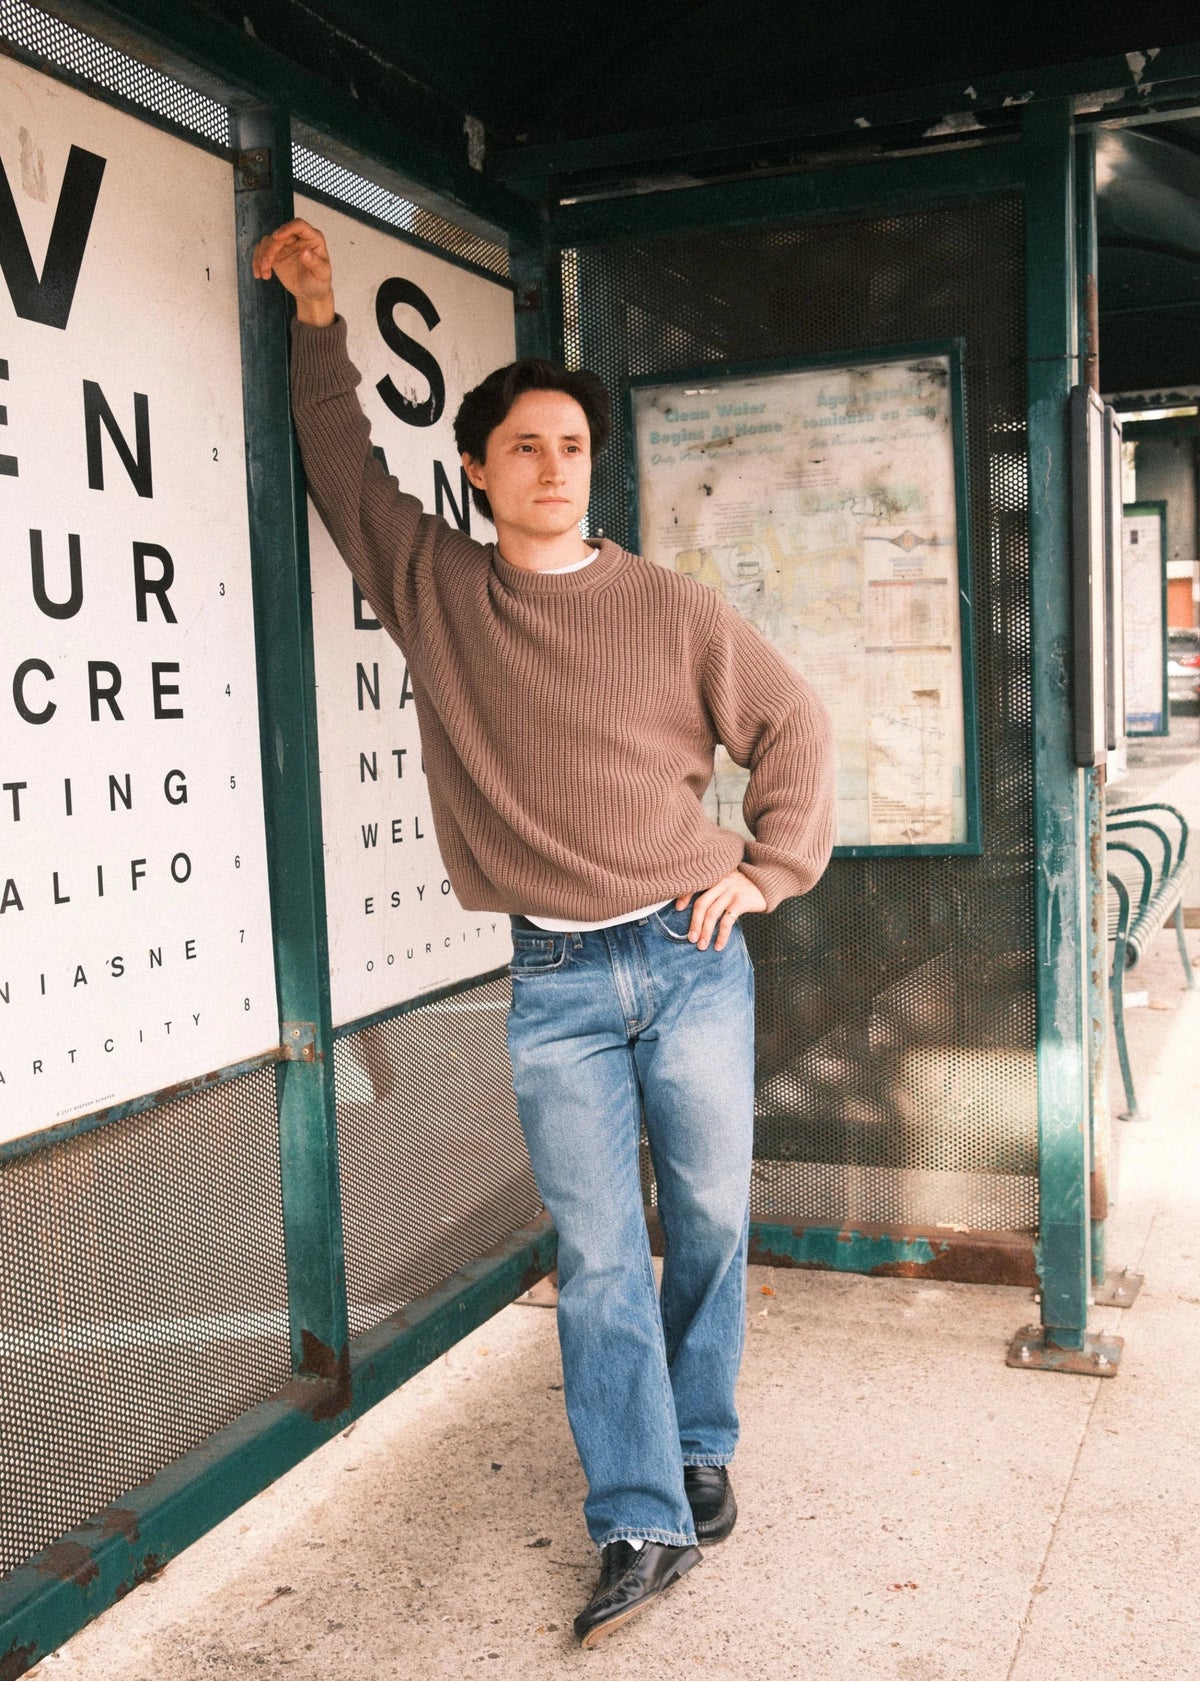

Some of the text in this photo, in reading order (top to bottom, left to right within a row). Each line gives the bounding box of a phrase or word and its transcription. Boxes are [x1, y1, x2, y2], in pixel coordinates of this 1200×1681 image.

[0, 144, 107, 330] V
[206, 266, 211, 281] 1
[376, 277, 446, 427] S
[664, 403, 767, 422] Clean Water
[650, 428, 704, 446] Begins
[736, 422, 783, 437] Home
[212, 446, 219, 462] 2
[29, 528, 178, 624] UR
[219, 582, 225, 597] 3
[12, 658, 184, 725] CRE
[225, 683, 231, 697] 4
[359, 749, 425, 783] NT
[230, 775, 236, 789] 5
[2, 769, 188, 822] TING
[361, 816, 424, 848] WEL
[234, 855, 241, 869] 6
[0, 852, 192, 915] ALIFO
[239, 929, 245, 943] 7
[244, 997, 250, 1011] 8
